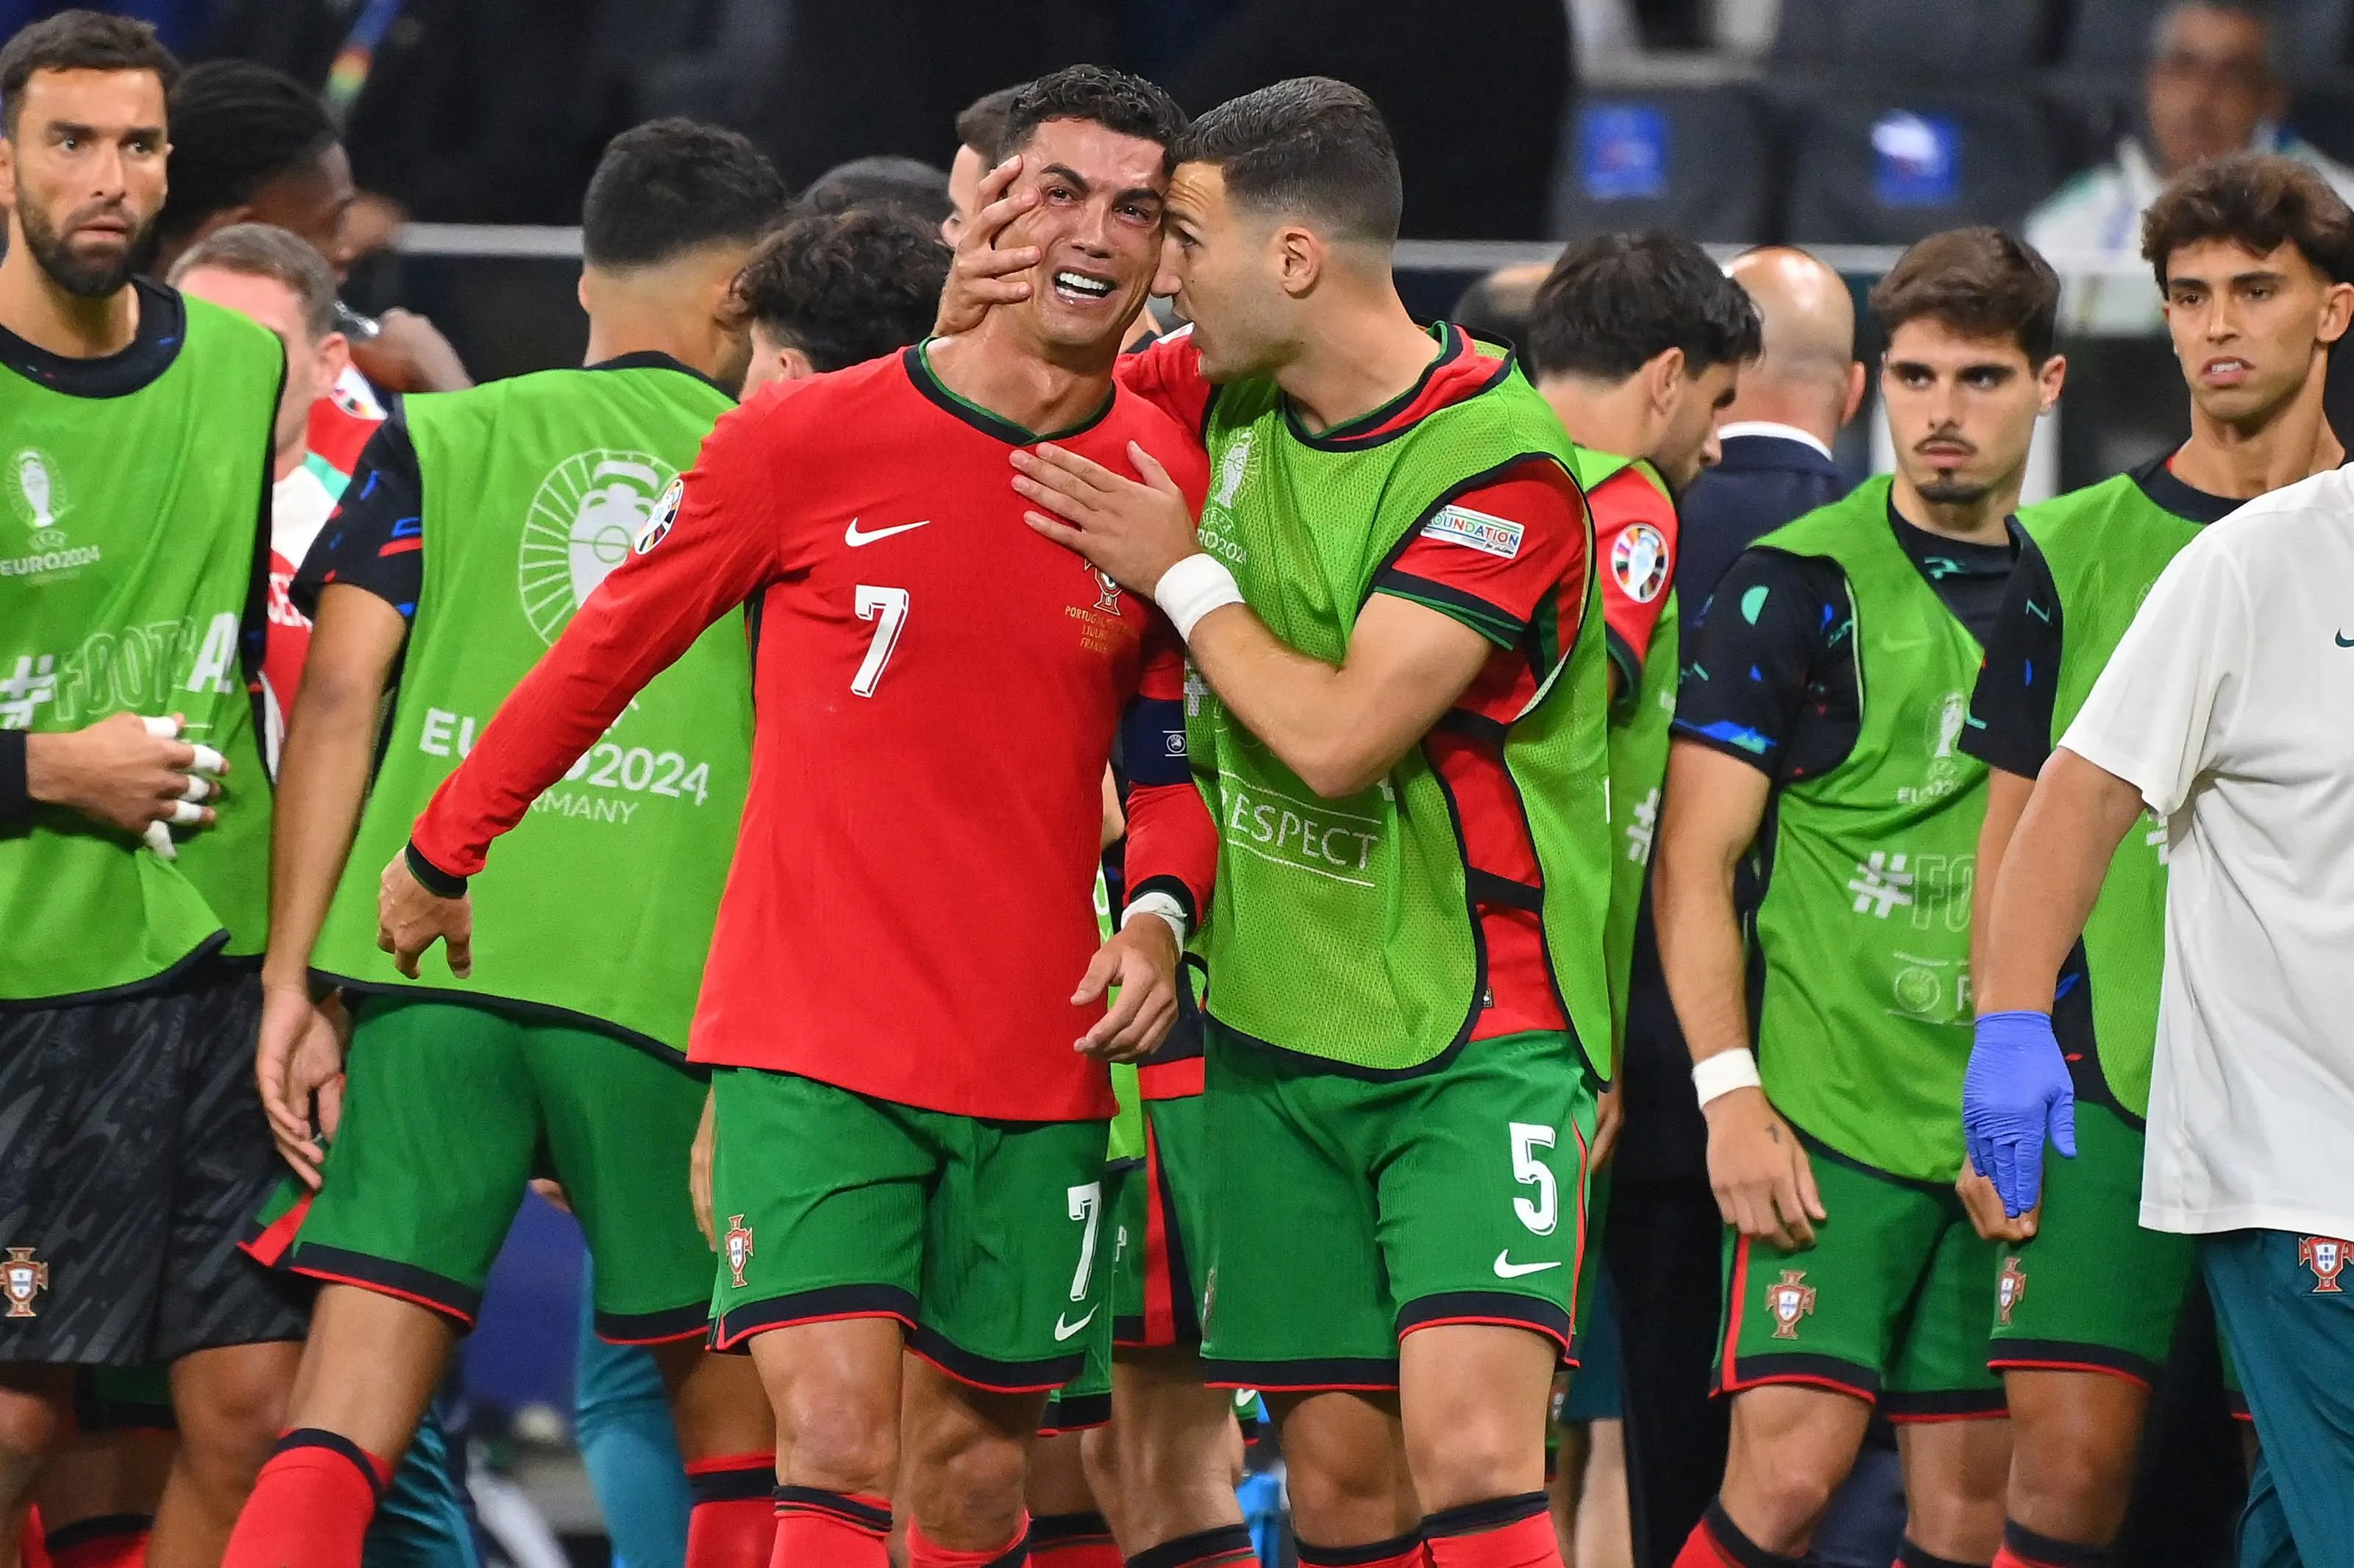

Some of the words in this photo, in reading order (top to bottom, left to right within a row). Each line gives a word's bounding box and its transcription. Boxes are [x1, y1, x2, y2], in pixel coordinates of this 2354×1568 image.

[1429, 513, 1520, 547] OUNDATION
[850, 585, 910, 698] 7
[1509, 1122, 1558, 1236] 5
[1067, 1180, 1102, 1302] 7
